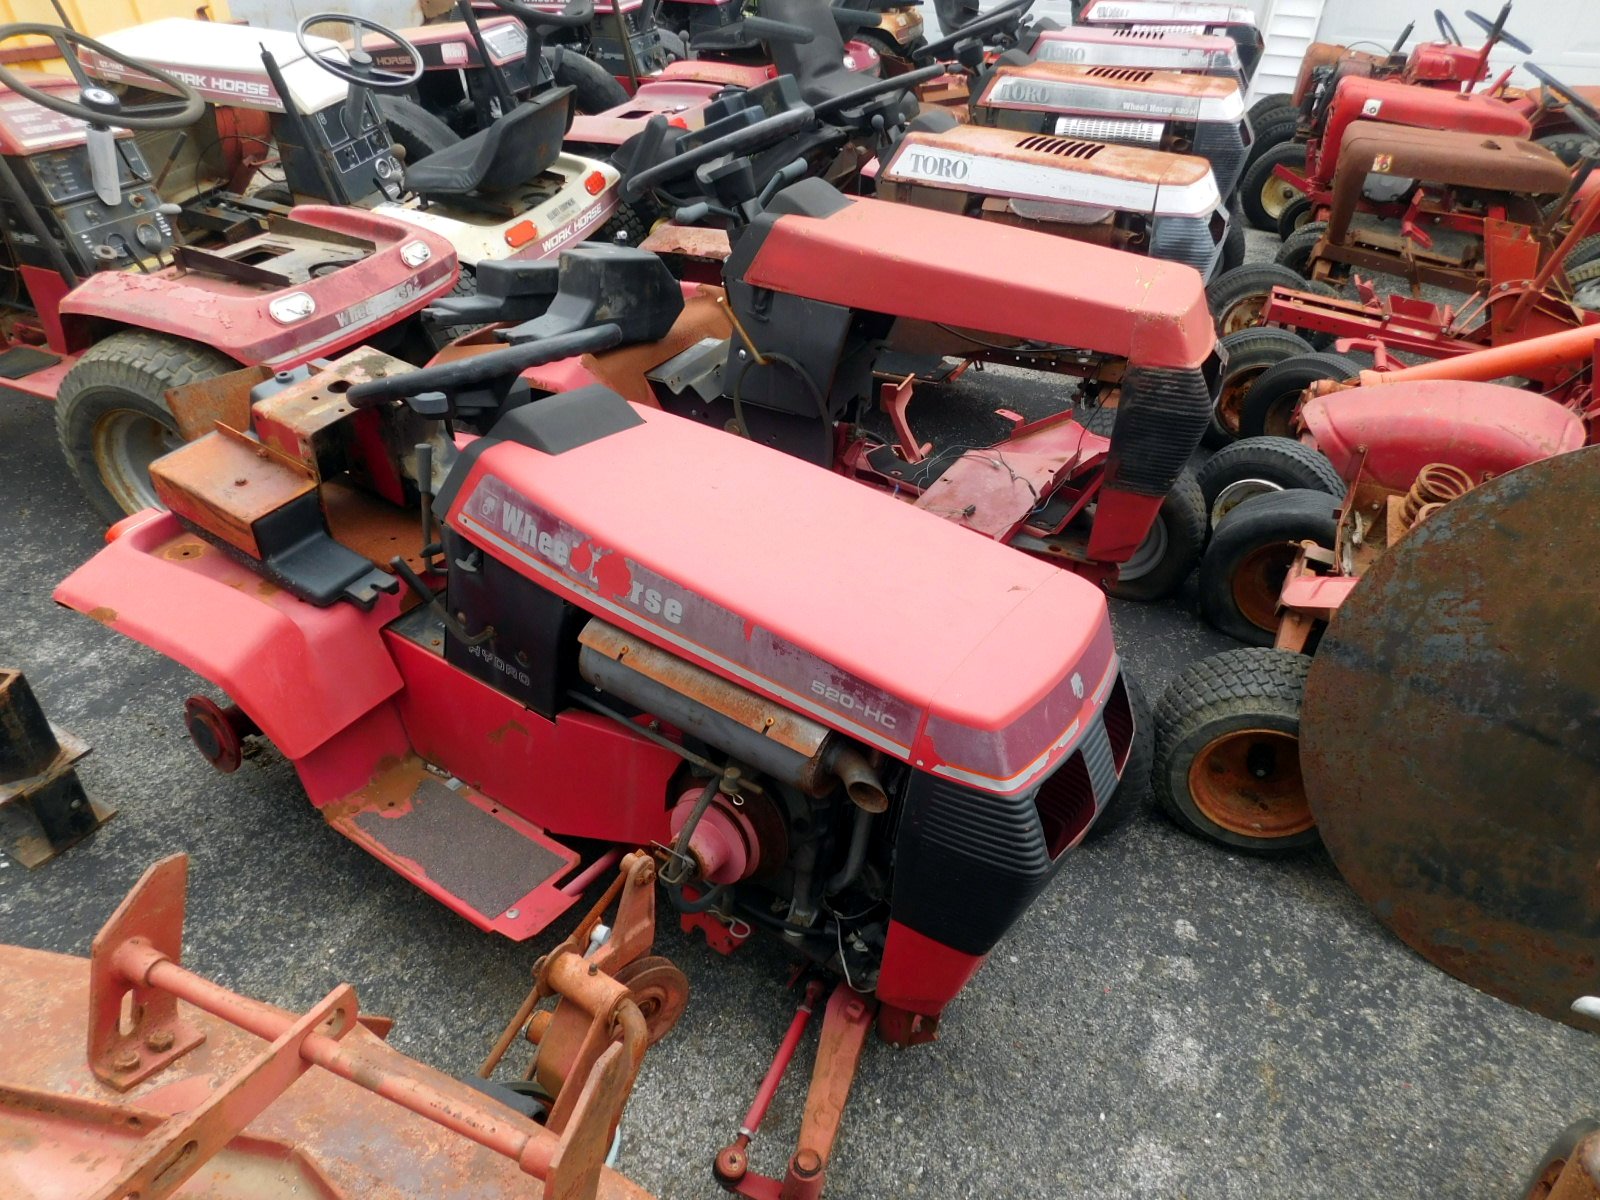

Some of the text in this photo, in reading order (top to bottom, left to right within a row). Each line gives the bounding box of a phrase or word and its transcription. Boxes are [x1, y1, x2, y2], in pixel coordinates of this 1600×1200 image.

[375, 55, 413, 66] HORSE
[211, 77, 270, 96] HORSE
[1001, 84, 1051, 103] TORO
[1122, 102, 1148, 112] Wheel
[1149, 104, 1174, 114] Horse
[910, 153, 968, 180] TORO
[542, 225, 572, 252] WORK
[573, 203, 602, 232] HORSE
[502, 500, 580, 572] Whee
[468, 645, 530, 687] HYDRO
[810, 679, 897, 731] 520-HC
